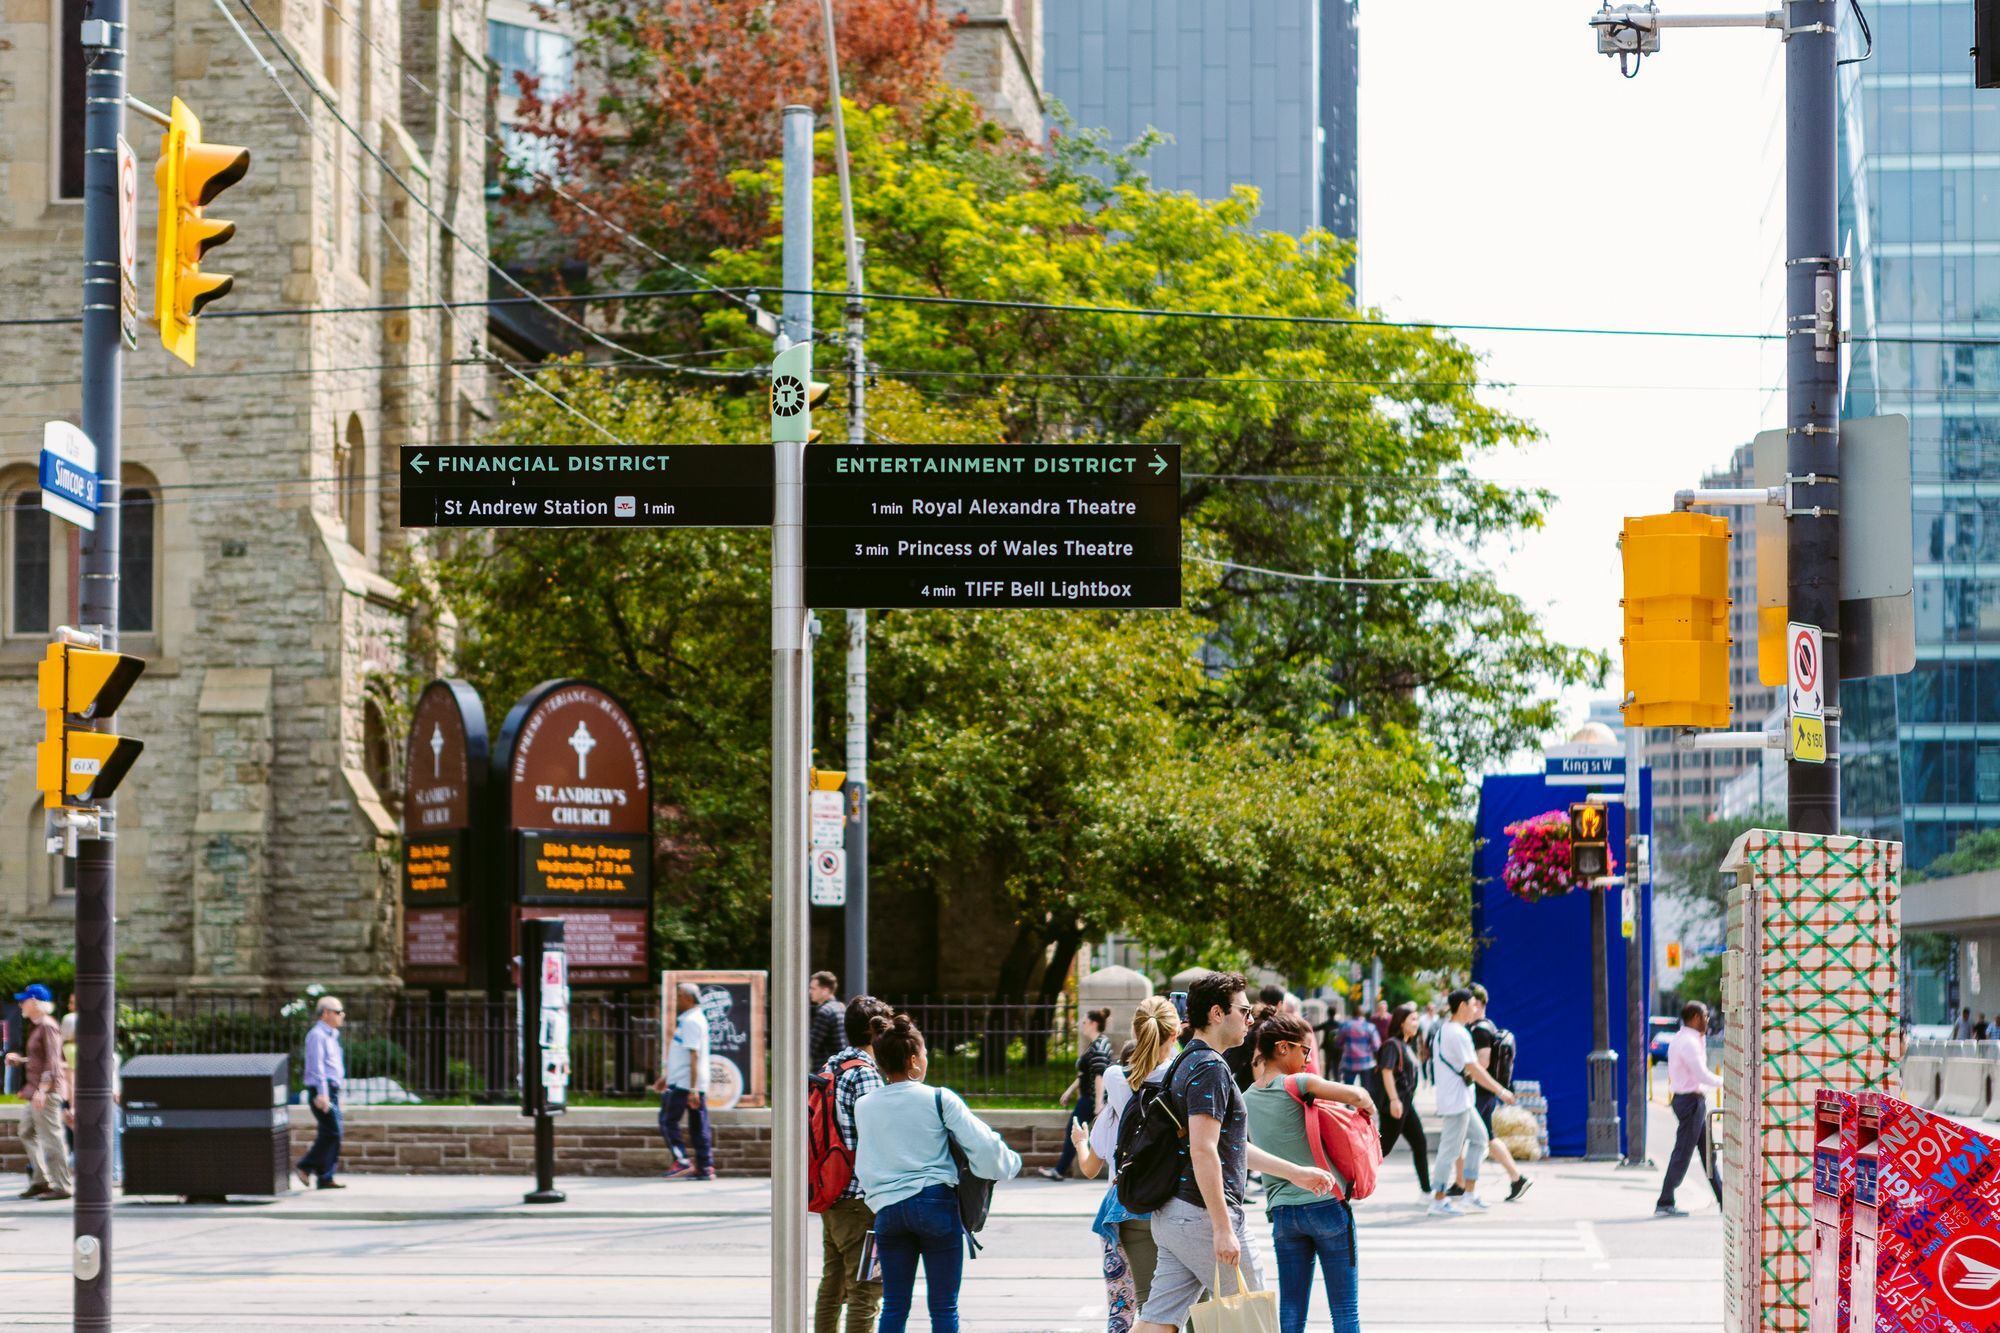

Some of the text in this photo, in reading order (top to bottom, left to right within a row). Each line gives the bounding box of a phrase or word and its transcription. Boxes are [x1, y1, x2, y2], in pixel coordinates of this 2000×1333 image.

[438, 455, 670, 472] FINANCIAL DISTRICT
[836, 457, 1137, 474] ENTERTAINMENT DISTRICT
[55, 459, 85, 498] Simcoe
[444, 500, 463, 515] St
[468, 499, 537, 515] Andrew
[543, 499, 608, 515] Station
[643, 503, 649, 515] 1
[652, 502, 675, 515] min
[871, 499, 1136, 518] 1 min Royal Alexandra Theatre
[855, 540, 1134, 556] 3 min Princess of Wales Theatre
[921, 581, 1132, 601] 4 min TIFF Bell Lightbox
[1562, 759, 1589, 774] King
[1602, 758, 1612, 772] W
[552, 806, 611, 826] CHURCH
[543, 843, 631, 861] Bible Study Groups
[536, 859, 594, 876] Wednesdays
[595, 861, 614, 874] 7:30
[546, 875, 585, 893] Sundays
[126, 1114, 150, 1128] Litter
[1900, 1122, 1965, 1179] P9A
[1931, 1136, 1991, 1189] K4A
[1878, 1163, 1925, 1205] H9X
[1966, 1160, 1994, 1187] E3N
[1913, 1179, 1947, 1205] J6V
[1972, 1181, 1991, 1196] Y1A
[1952, 1183, 1990, 1222] B4E
[1895, 1203, 1936, 1239] V6K
[1939, 1212, 1960, 1234] B2Z
[1950, 1205, 1970, 1226] G3N
[1877, 1223, 1905, 1256] X1A
[1890, 1262, 1926, 1301] V7J
[1881, 1288, 1911, 1312] J5T
[1900, 1297, 1936, 1324] V9L
